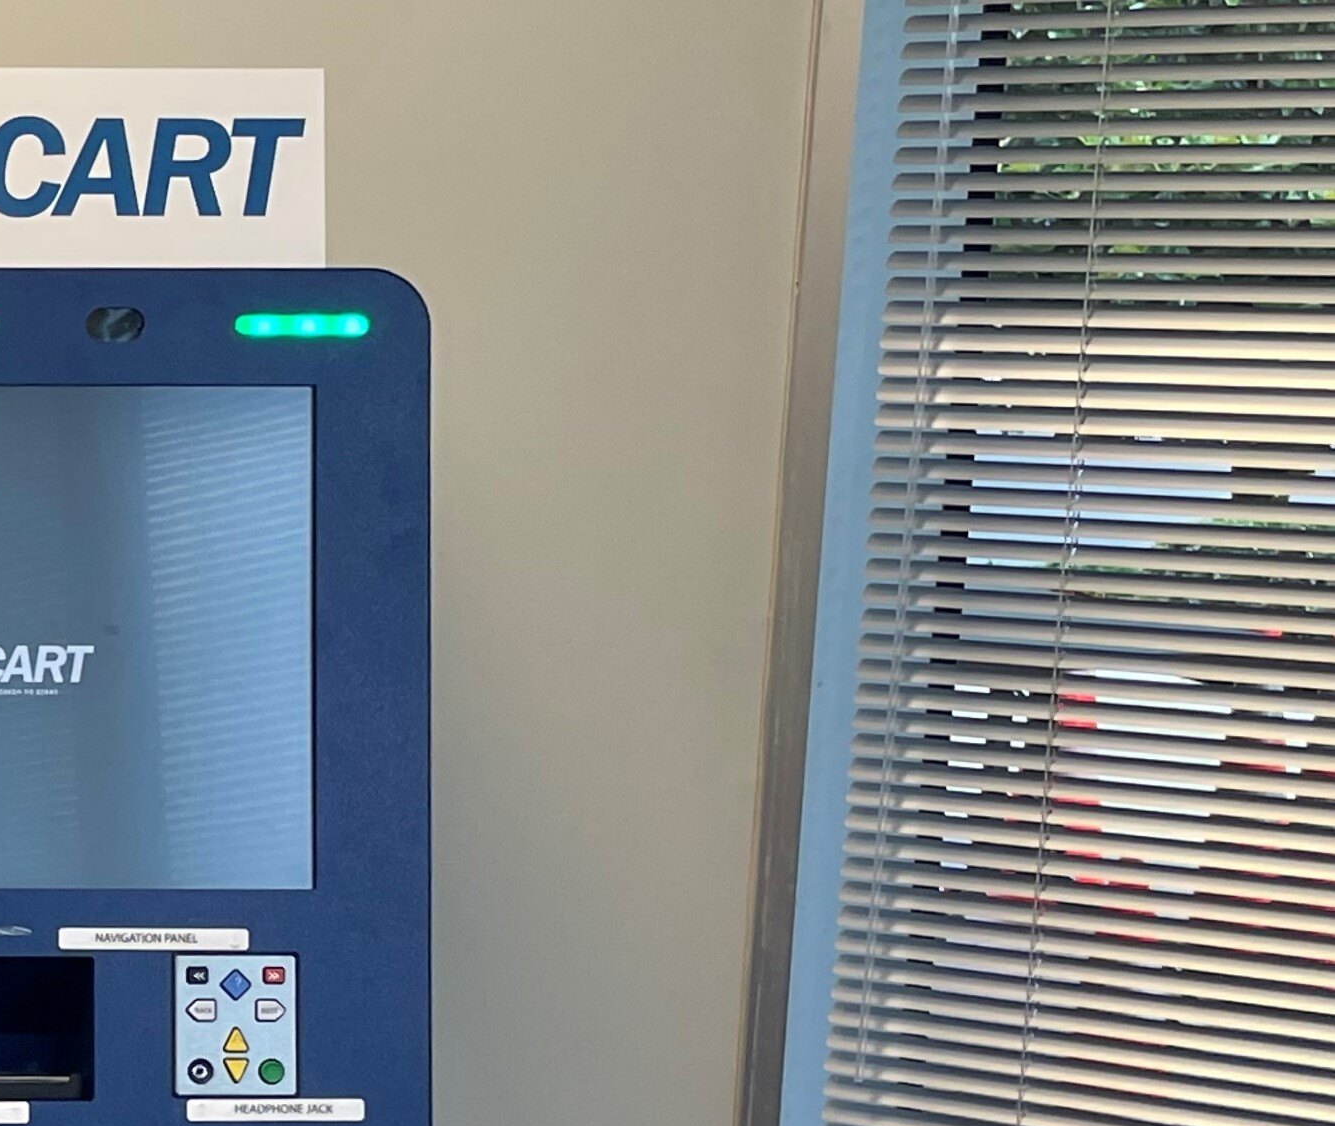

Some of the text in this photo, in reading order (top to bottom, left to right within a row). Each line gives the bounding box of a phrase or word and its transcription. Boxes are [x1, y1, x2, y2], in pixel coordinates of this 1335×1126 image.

[95, 932, 198, 944] NAVIGATION PANEL
[234, 1103, 334, 1114] HEADPHONE JACK
